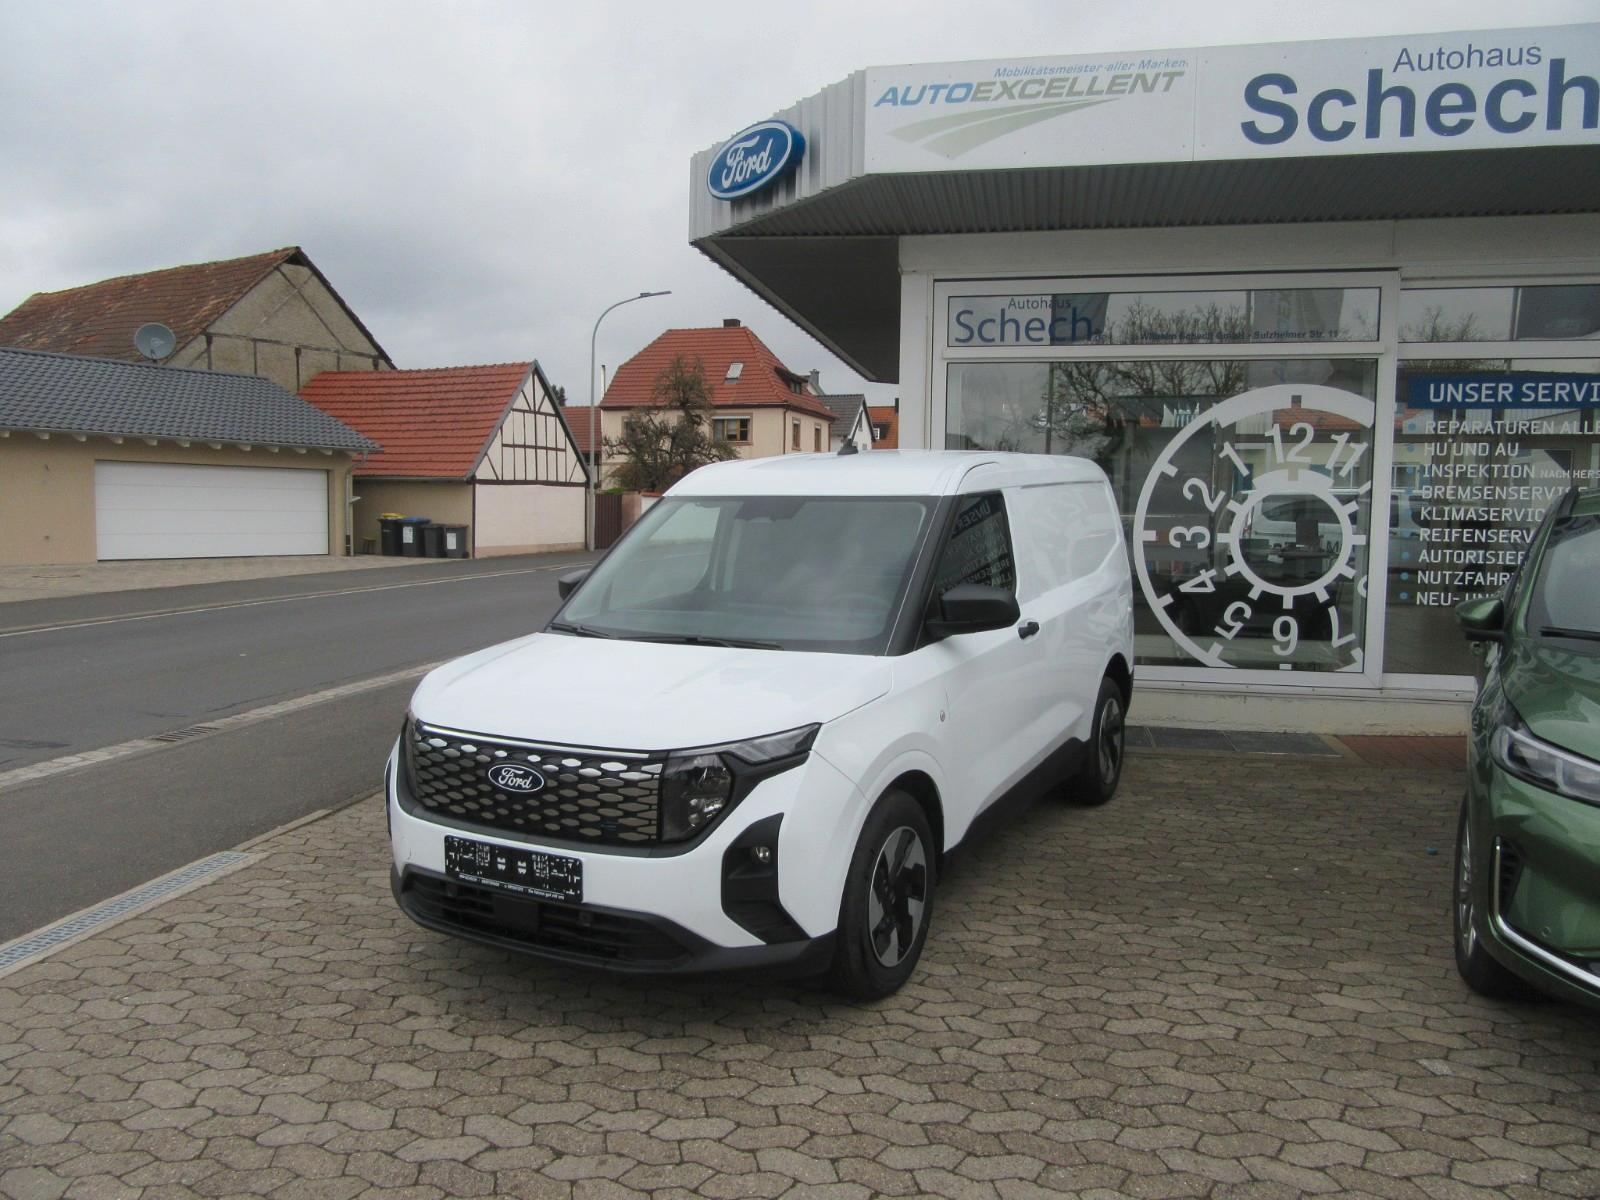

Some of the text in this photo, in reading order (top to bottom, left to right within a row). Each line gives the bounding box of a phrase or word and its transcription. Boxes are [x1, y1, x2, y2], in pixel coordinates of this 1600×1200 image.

[1393, 44, 1542, 73] Autohaus
[874, 71, 1185, 107] AUTOEXCELLENT
[1241, 58, 1600, 145] Schech
[722, 135, 772, 189] Ford
[1008, 297, 1072, 309] Autohaus
[955, 307, 1093, 343] Schech
[1429, 382, 1600, 403] UNSER SERVI
[1425, 420, 1554, 435] REPARATUREN
[1264, 422, 1315, 464] 12
[1325, 431, 1369, 478] 11
[1424, 442, 1519, 457] HU UND AU
[1218, 441, 1250, 477] 1
[1422, 463, 1535, 479] INSPEKTION
[1540, 469, 1570, 479] NACH
[1182, 477, 1226, 513] 2
[1168, 526, 1211, 549] 3
[1178, 568, 1217, 593] 4
[1416, 591, 1460, 606] NEU-
[498, 767, 532, 789] Ford
